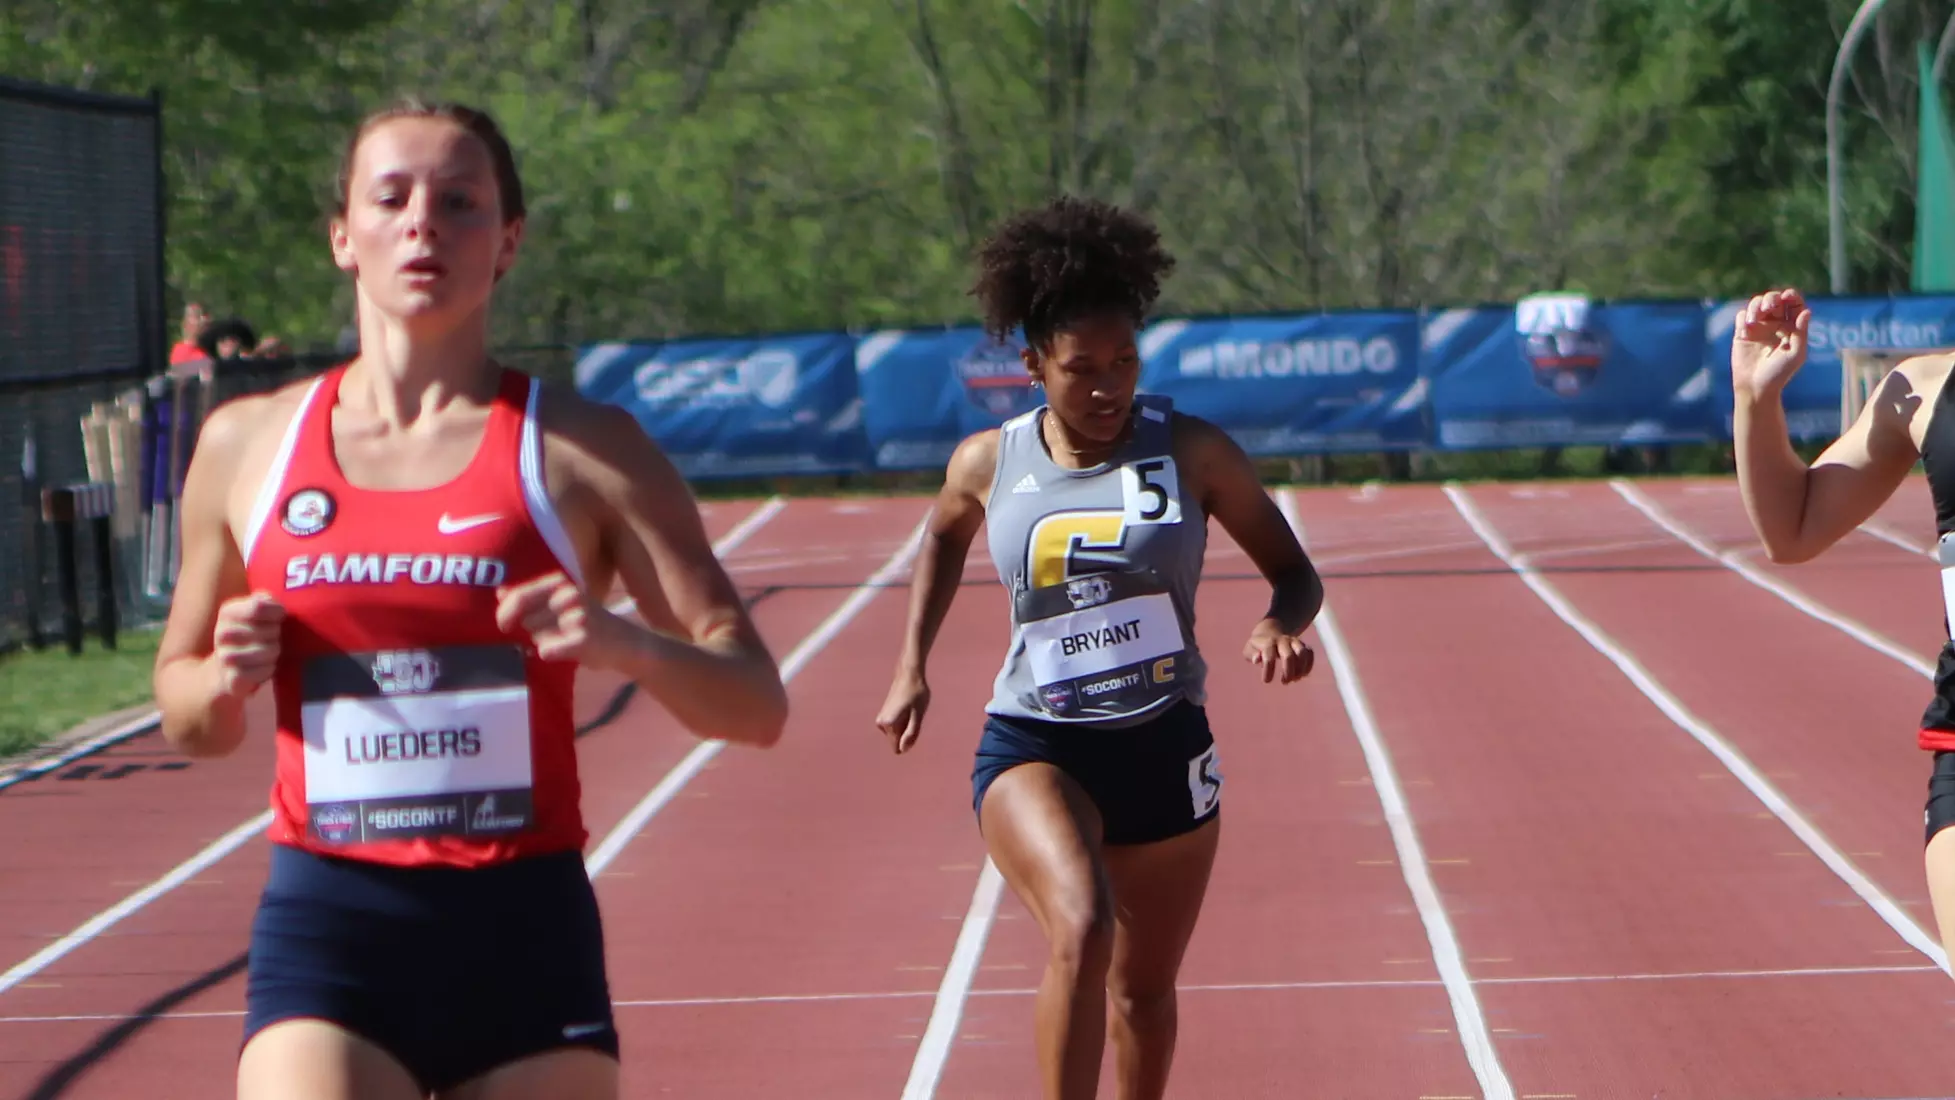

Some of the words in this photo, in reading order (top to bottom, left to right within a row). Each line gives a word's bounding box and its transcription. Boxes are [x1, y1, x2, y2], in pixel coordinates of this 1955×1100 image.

[1807, 319, 1940, 347] Stobitan
[1214, 338, 1398, 377] MONDO
[1136, 461, 1168, 520] 5
[286, 554, 505, 588] SAMFORD
[1061, 619, 1141, 656] BRYANT
[1153, 657, 1175, 683] C
[345, 729, 481, 765] LUEDERS
[1199, 752, 1220, 811] 5
[368, 805, 457, 830] #SOCONTF
